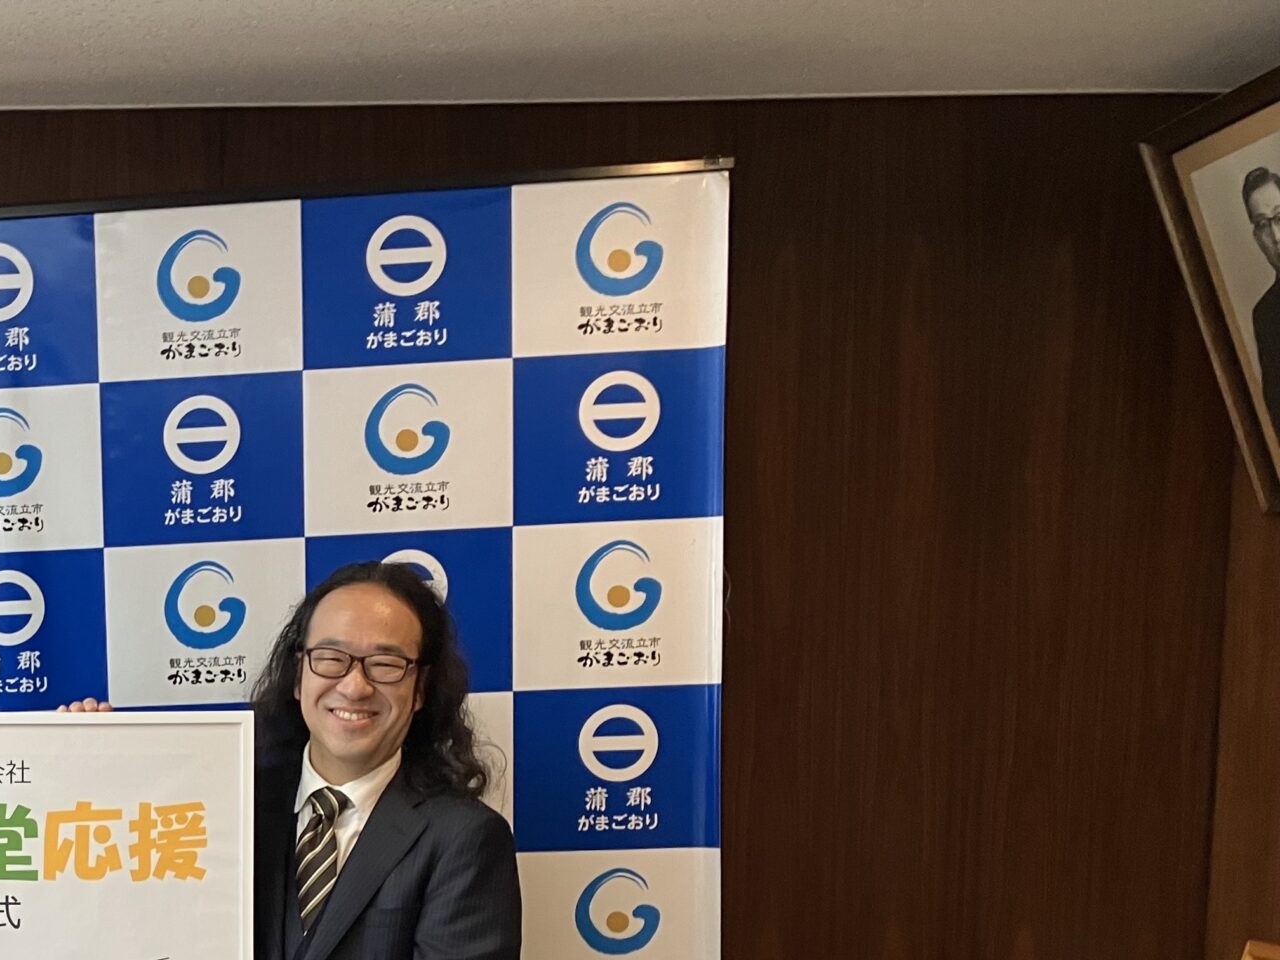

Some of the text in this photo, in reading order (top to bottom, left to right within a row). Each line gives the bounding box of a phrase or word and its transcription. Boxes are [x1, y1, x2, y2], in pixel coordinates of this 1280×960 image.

[373, 300, 440, 327] 蒲郡
[579, 302, 663, 318] 観光交流立市
[161, 327, 241, 342] 観光交流立市
[577, 316, 664, 335] がまごおり
[366, 329, 447, 350] がまごおり
[160, 342, 242, 361] がまごおり
[586, 456, 653, 482] 蒲郡
[171, 479, 235, 504] 蒲郡
[369, 481, 449, 495] 観光交流立市
[578, 483, 661, 504] がまごおり
[367, 493, 450, 513] がまごおり
[164, 506, 242, 526] がまごおり
[579, 637, 661, 652] 観光交流立市
[169, 655, 246, 670] 観光交流立市
[577, 649, 662, 668] がまごおり
[167, 667, 247, 685] がまごおり
[585, 787, 651, 812] 蒲郡
[577, 813, 658, 832] がまごおり
